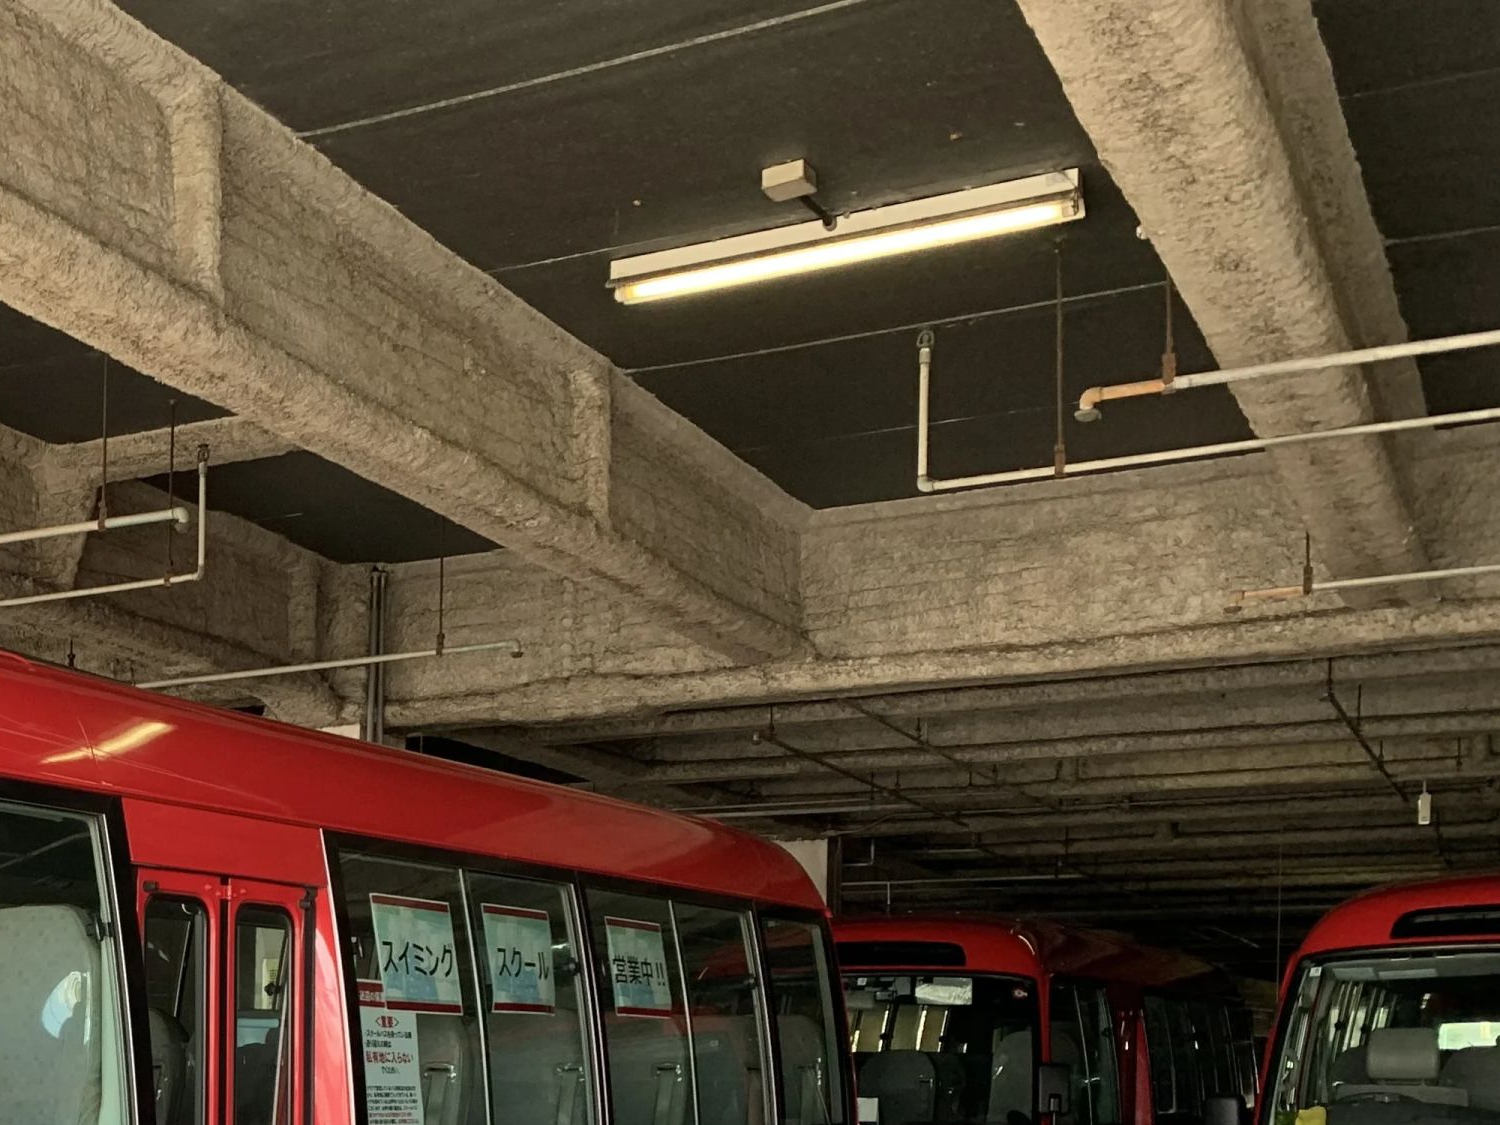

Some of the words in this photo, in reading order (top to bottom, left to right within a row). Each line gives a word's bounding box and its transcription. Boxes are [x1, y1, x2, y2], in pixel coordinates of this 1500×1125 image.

[381, 940, 453, 978] スイミング
[497, 946, 549, 979] スクール
